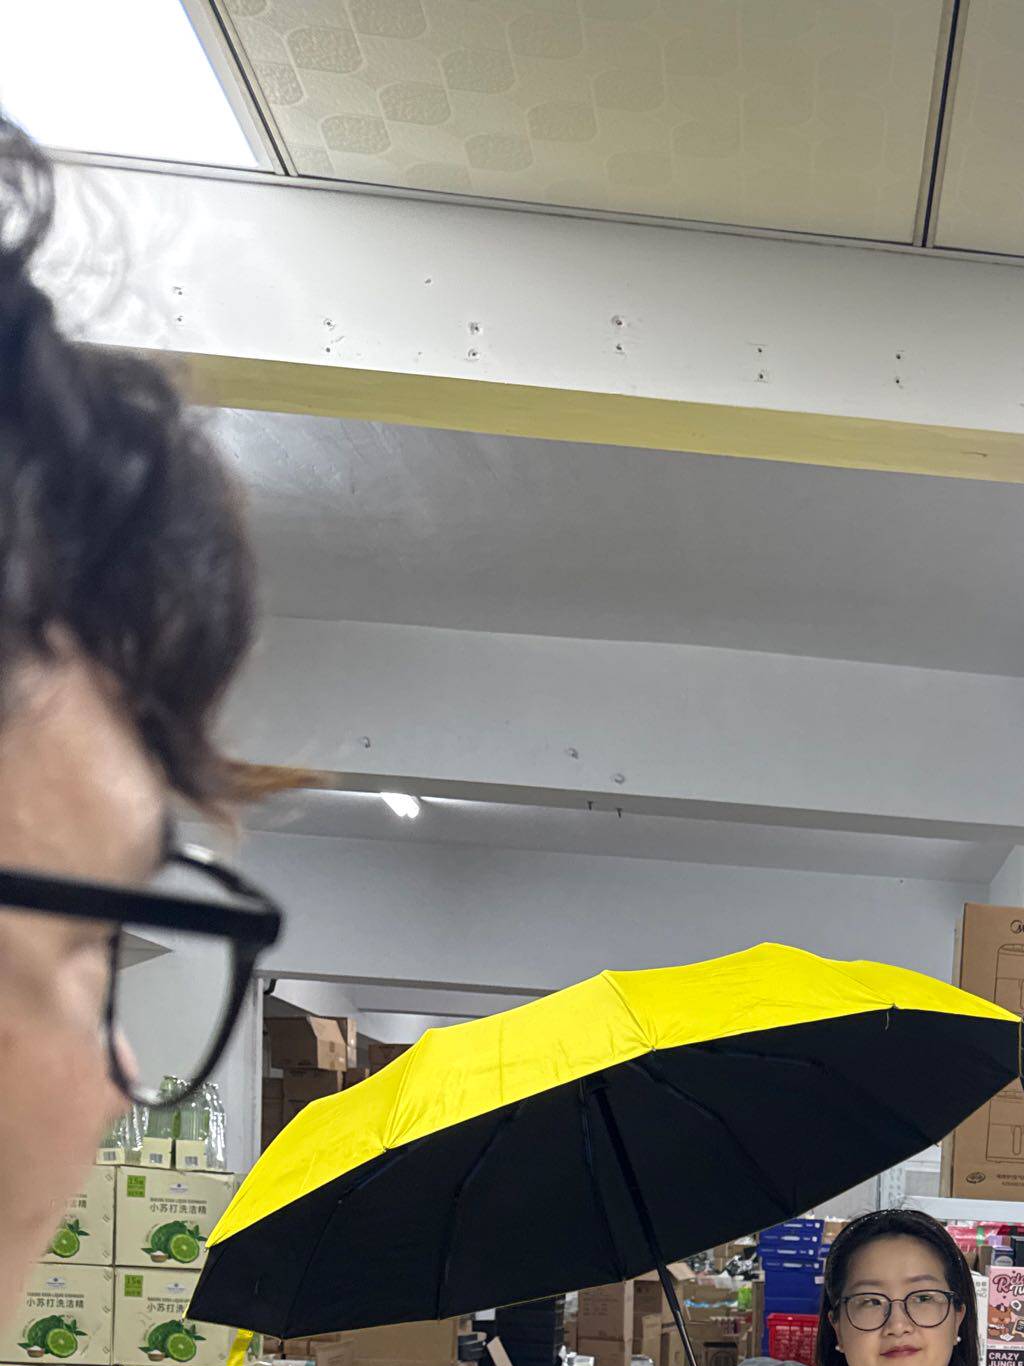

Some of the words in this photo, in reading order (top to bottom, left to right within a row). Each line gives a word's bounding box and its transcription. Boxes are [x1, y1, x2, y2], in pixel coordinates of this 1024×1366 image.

[150, 1203, 207, 1215] 小苏打洗洁精
[26, 1297, 85, 1309] 小苏打洗洁精
[988, 1351, 1019, 1360] CRAZY
